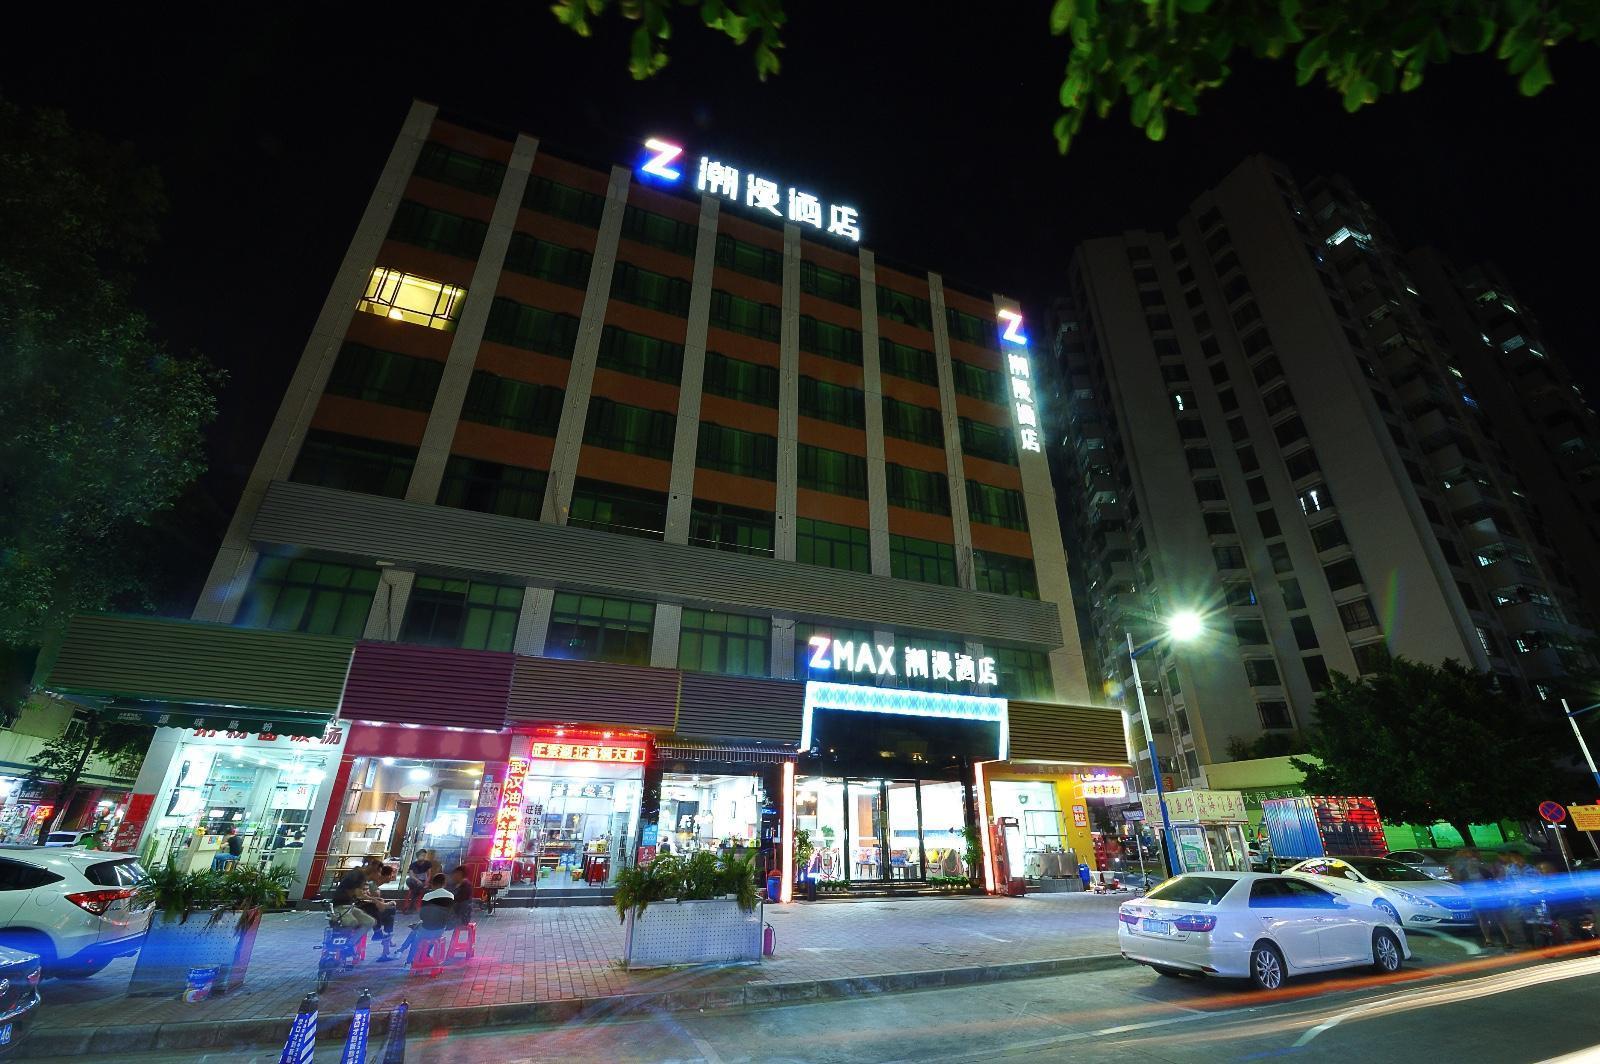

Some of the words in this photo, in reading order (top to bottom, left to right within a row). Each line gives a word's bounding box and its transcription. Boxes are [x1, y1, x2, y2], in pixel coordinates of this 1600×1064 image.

[642, 139, 682, 180] Z
[698, 157, 860, 241] 潮漫酒店
[998, 310, 1028, 345] Z
[1008, 354, 1041, 453] 潮漫酒店
[808, 637, 896, 676] ZMAX
[904, 647, 998, 686] 潮漫酒店
[524, 816, 541, 826] 转让
